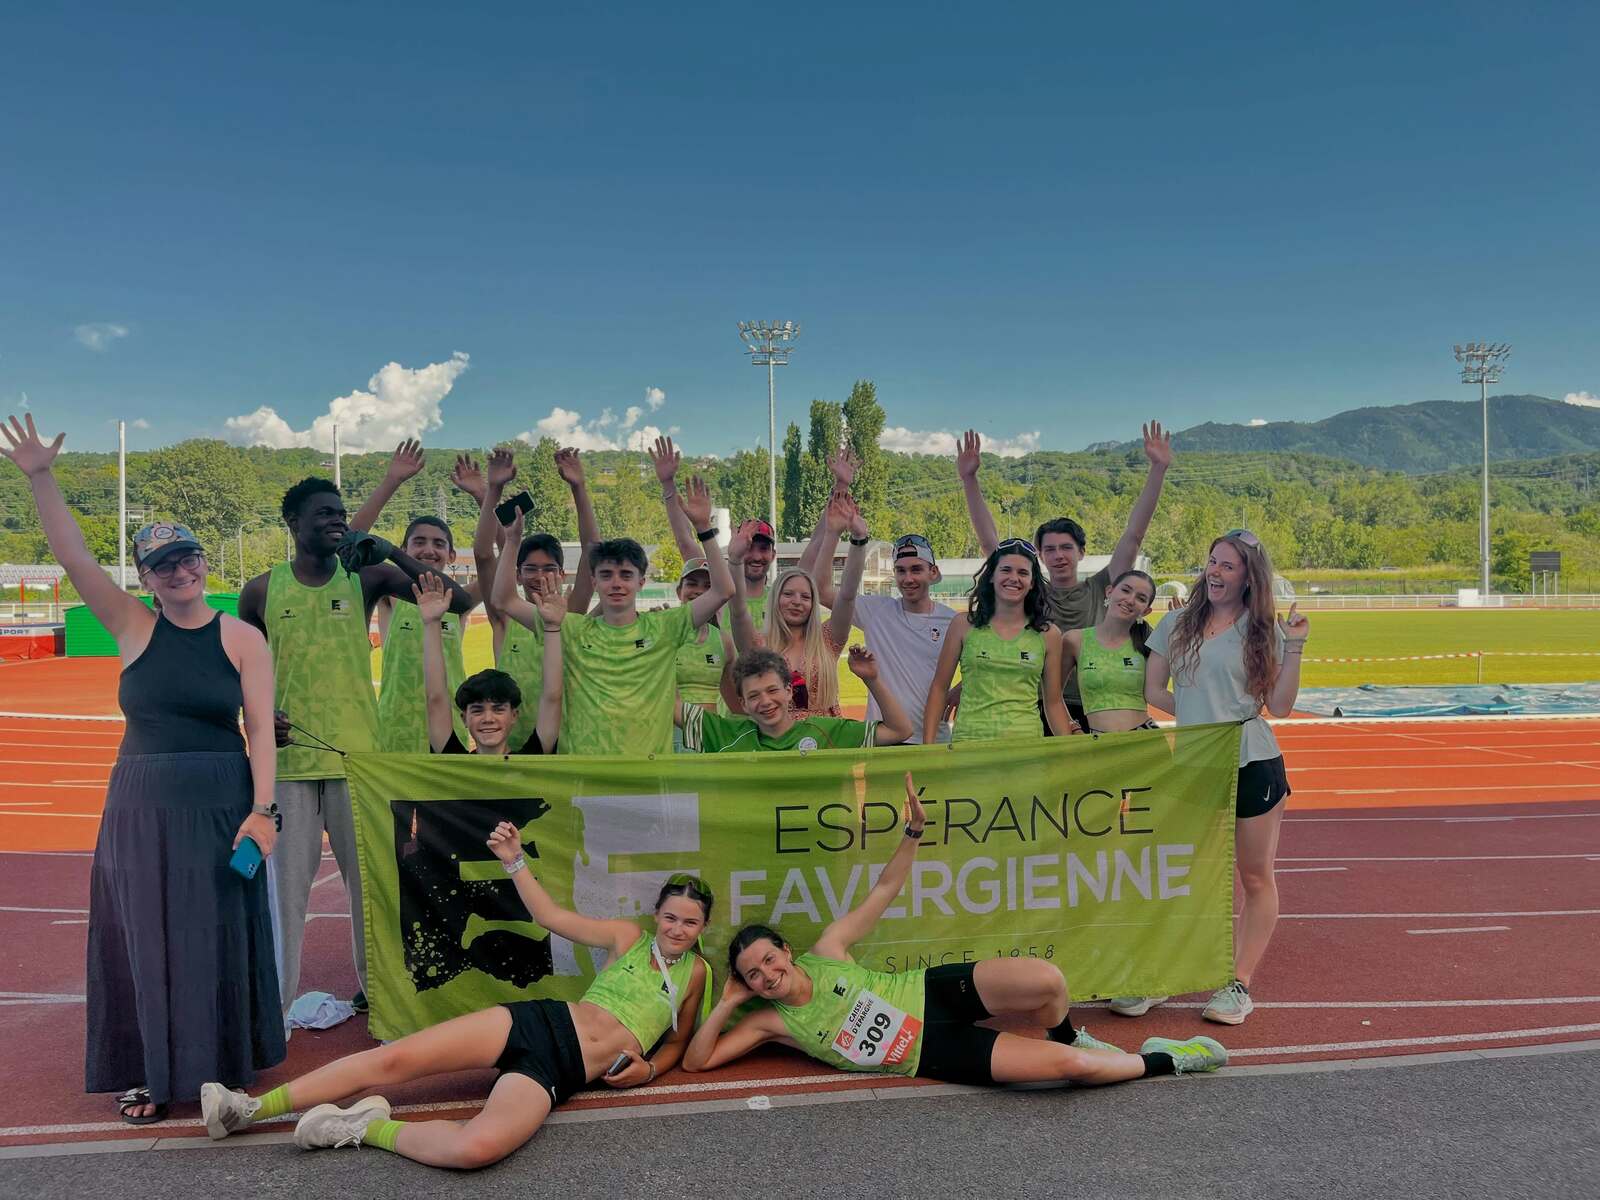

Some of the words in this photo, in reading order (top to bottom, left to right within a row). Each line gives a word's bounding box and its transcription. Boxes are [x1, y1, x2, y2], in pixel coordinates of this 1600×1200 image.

[775, 786, 1154, 854] ESPÉRANCE
[729, 844, 1194, 926] FAVERGIENNE
[885, 950, 975, 974] SINCE
[848, 999, 864, 1023] CAISSE
[858, 1012, 891, 1057] 309
